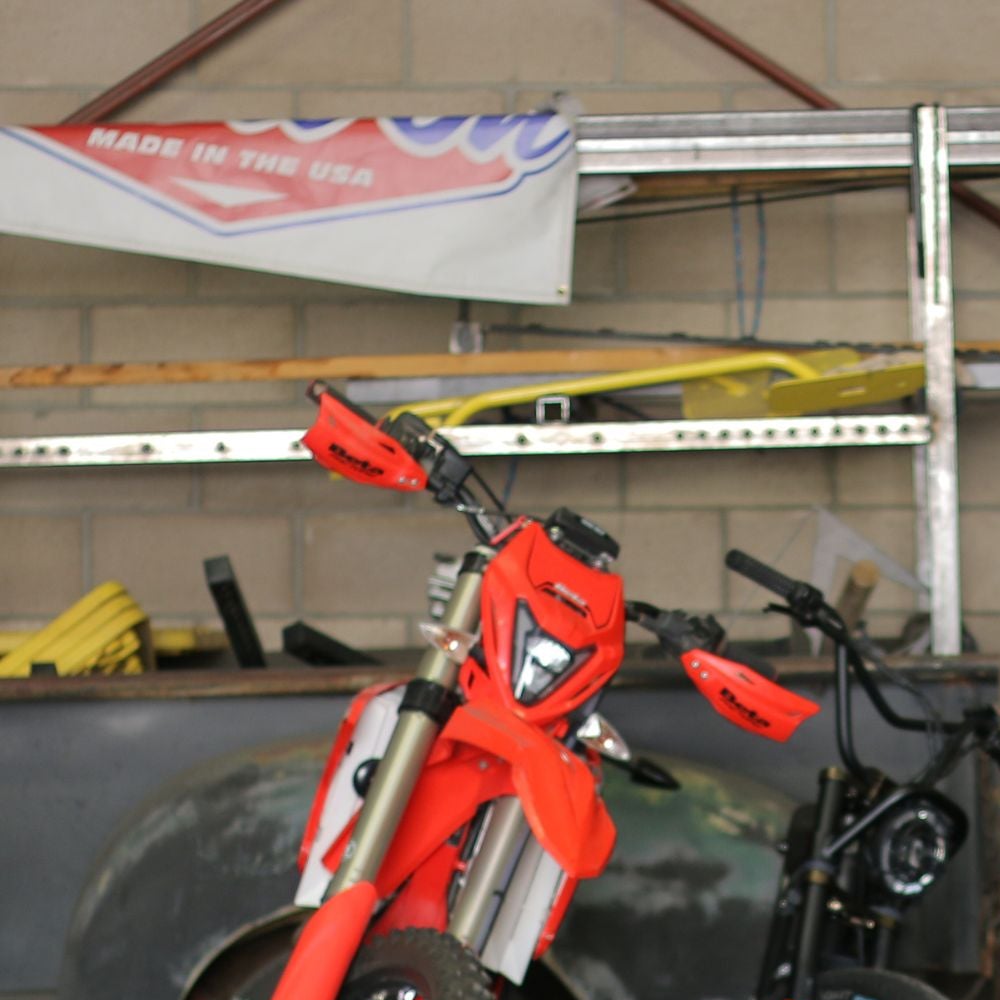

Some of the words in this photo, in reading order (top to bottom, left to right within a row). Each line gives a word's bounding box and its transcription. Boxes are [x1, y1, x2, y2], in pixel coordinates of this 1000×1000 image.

[86, 127, 184, 157] MADE
[191, 142, 229, 165] IN
[238, 149, 300, 177] THE
[308, 161, 375, 188] USA
